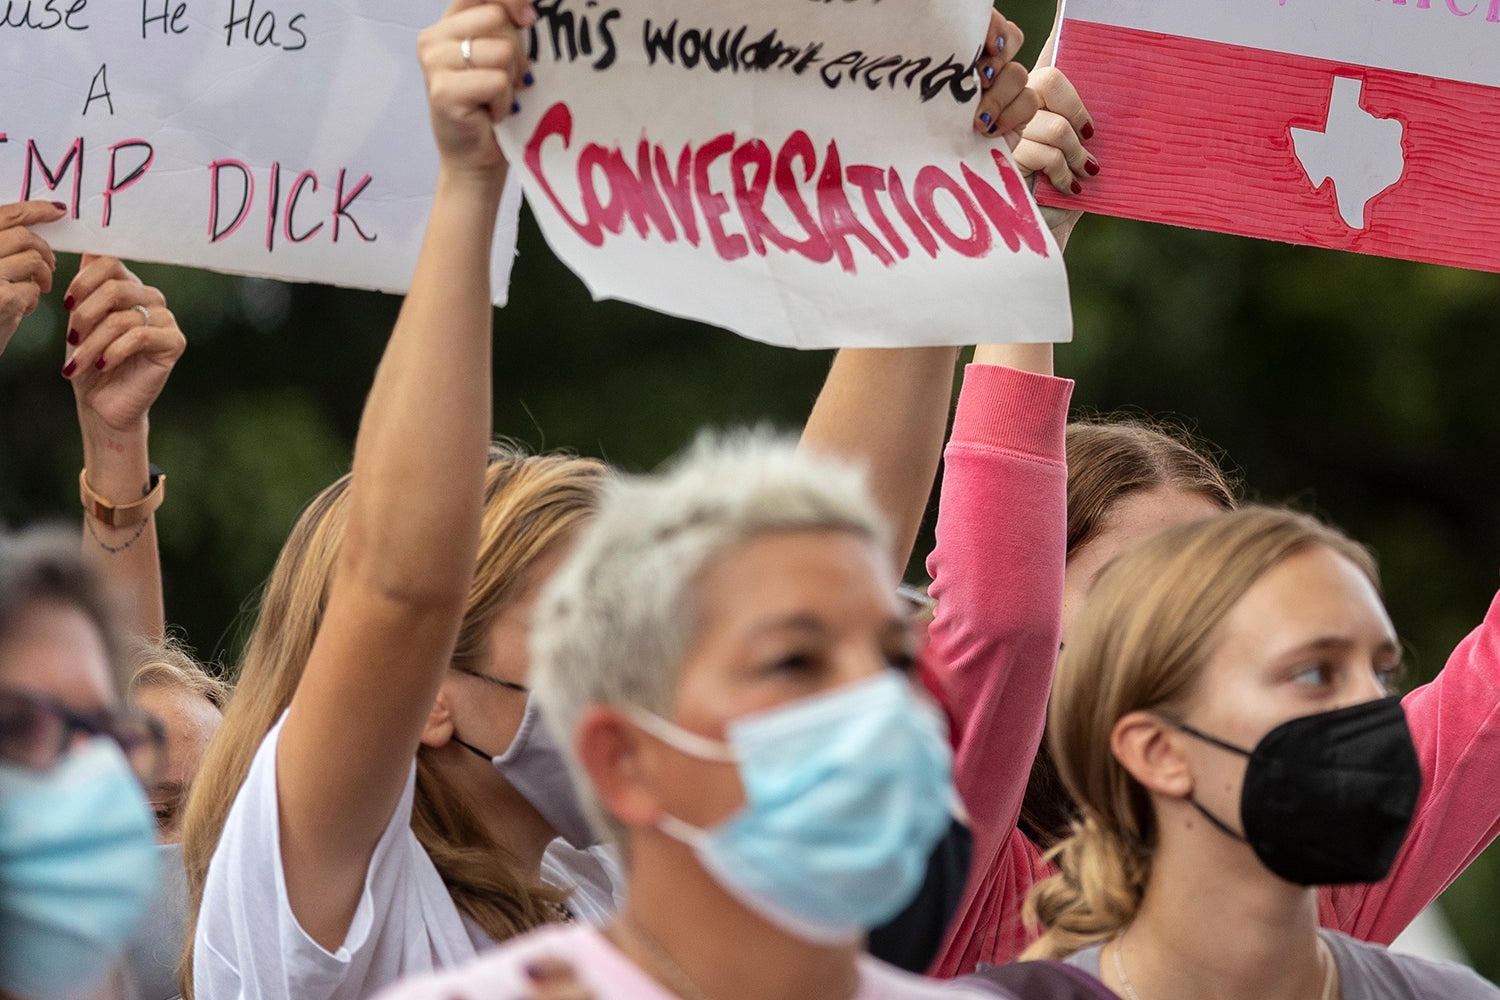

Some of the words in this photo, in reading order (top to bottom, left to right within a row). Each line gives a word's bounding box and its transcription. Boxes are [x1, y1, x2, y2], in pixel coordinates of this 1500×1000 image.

[83, 63, 113, 116] A
[821, 51, 931, 90] even
[0, 133, 154, 228] MP
[207, 158, 377, 252] DICK
[523, 102, 1050, 274] CONVERSATION
